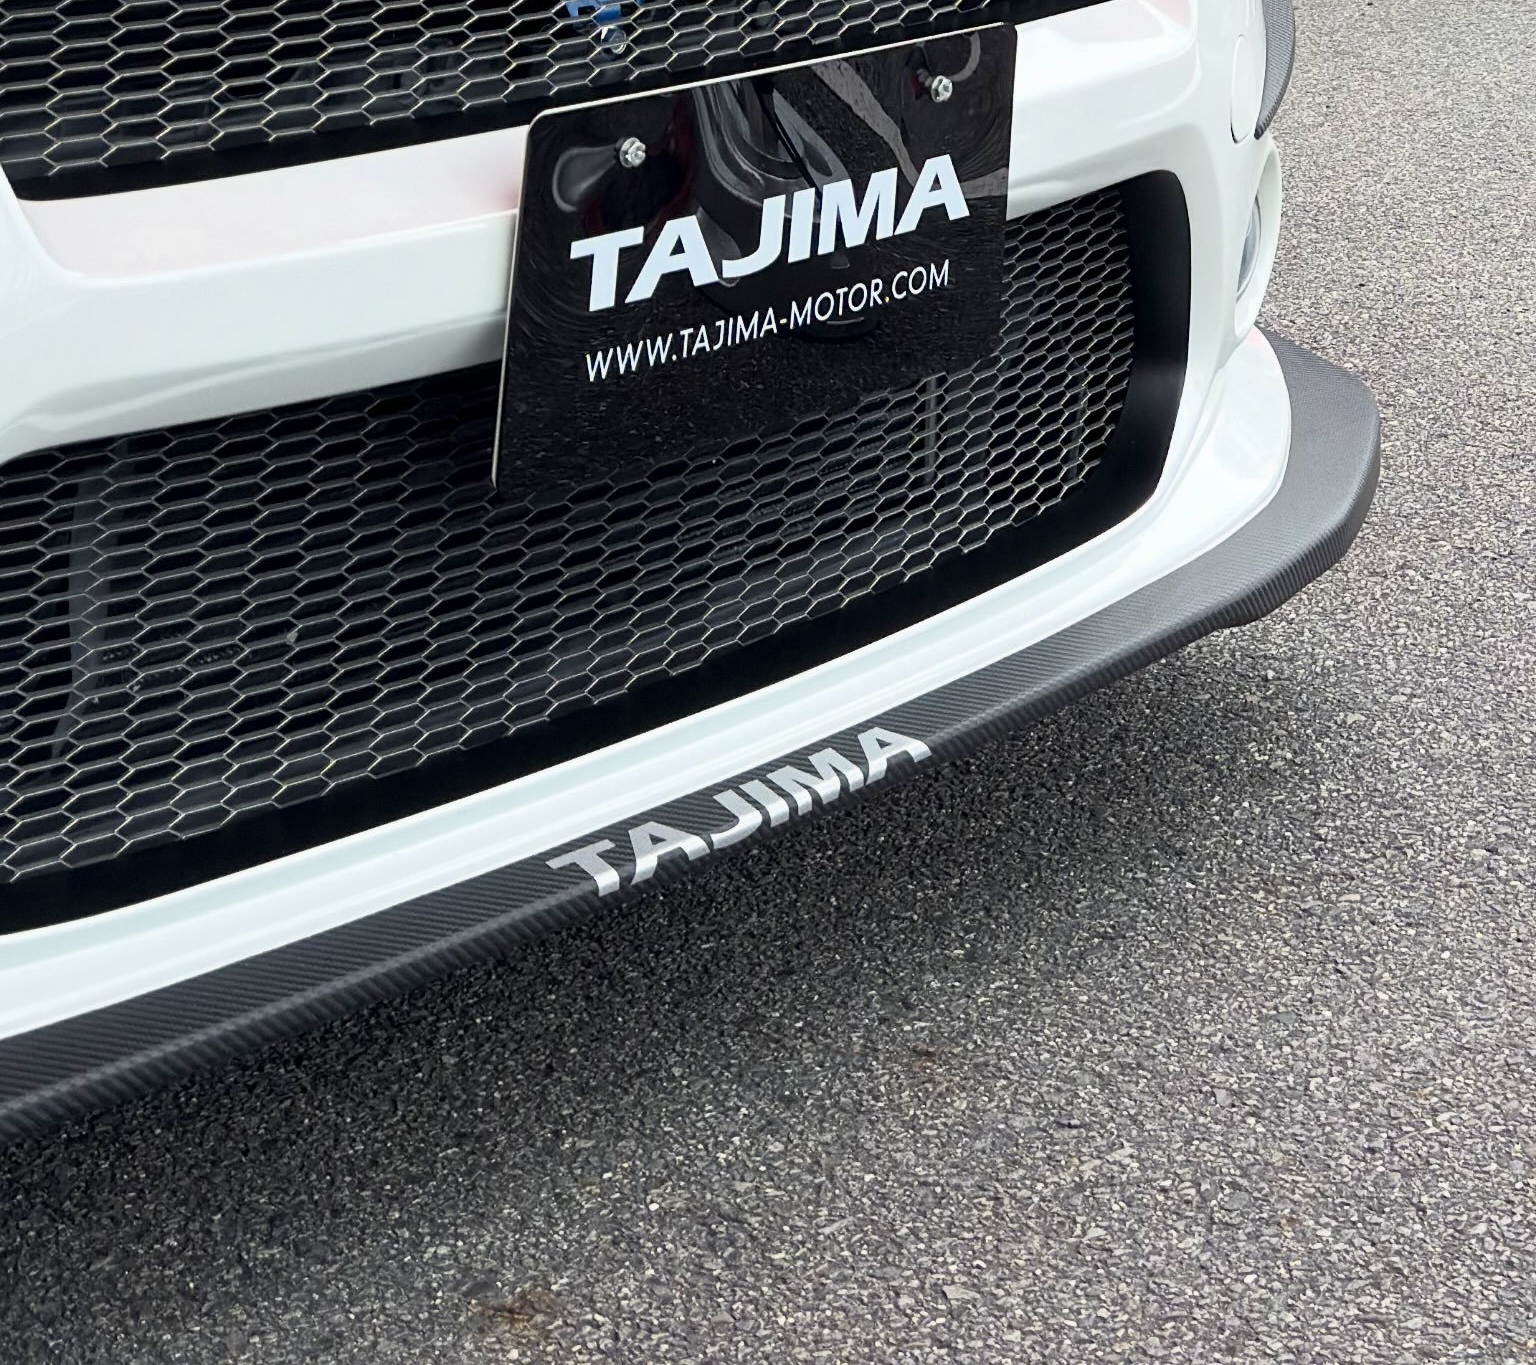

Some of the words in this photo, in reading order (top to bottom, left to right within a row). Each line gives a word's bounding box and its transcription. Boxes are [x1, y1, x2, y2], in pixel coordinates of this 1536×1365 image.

[569, 153, 970, 312] TAJIMA
[585, 259, 950, 382] WWW.TAJIMA-MOTOR.COM
[545, 725, 932, 897] TAJIMA
